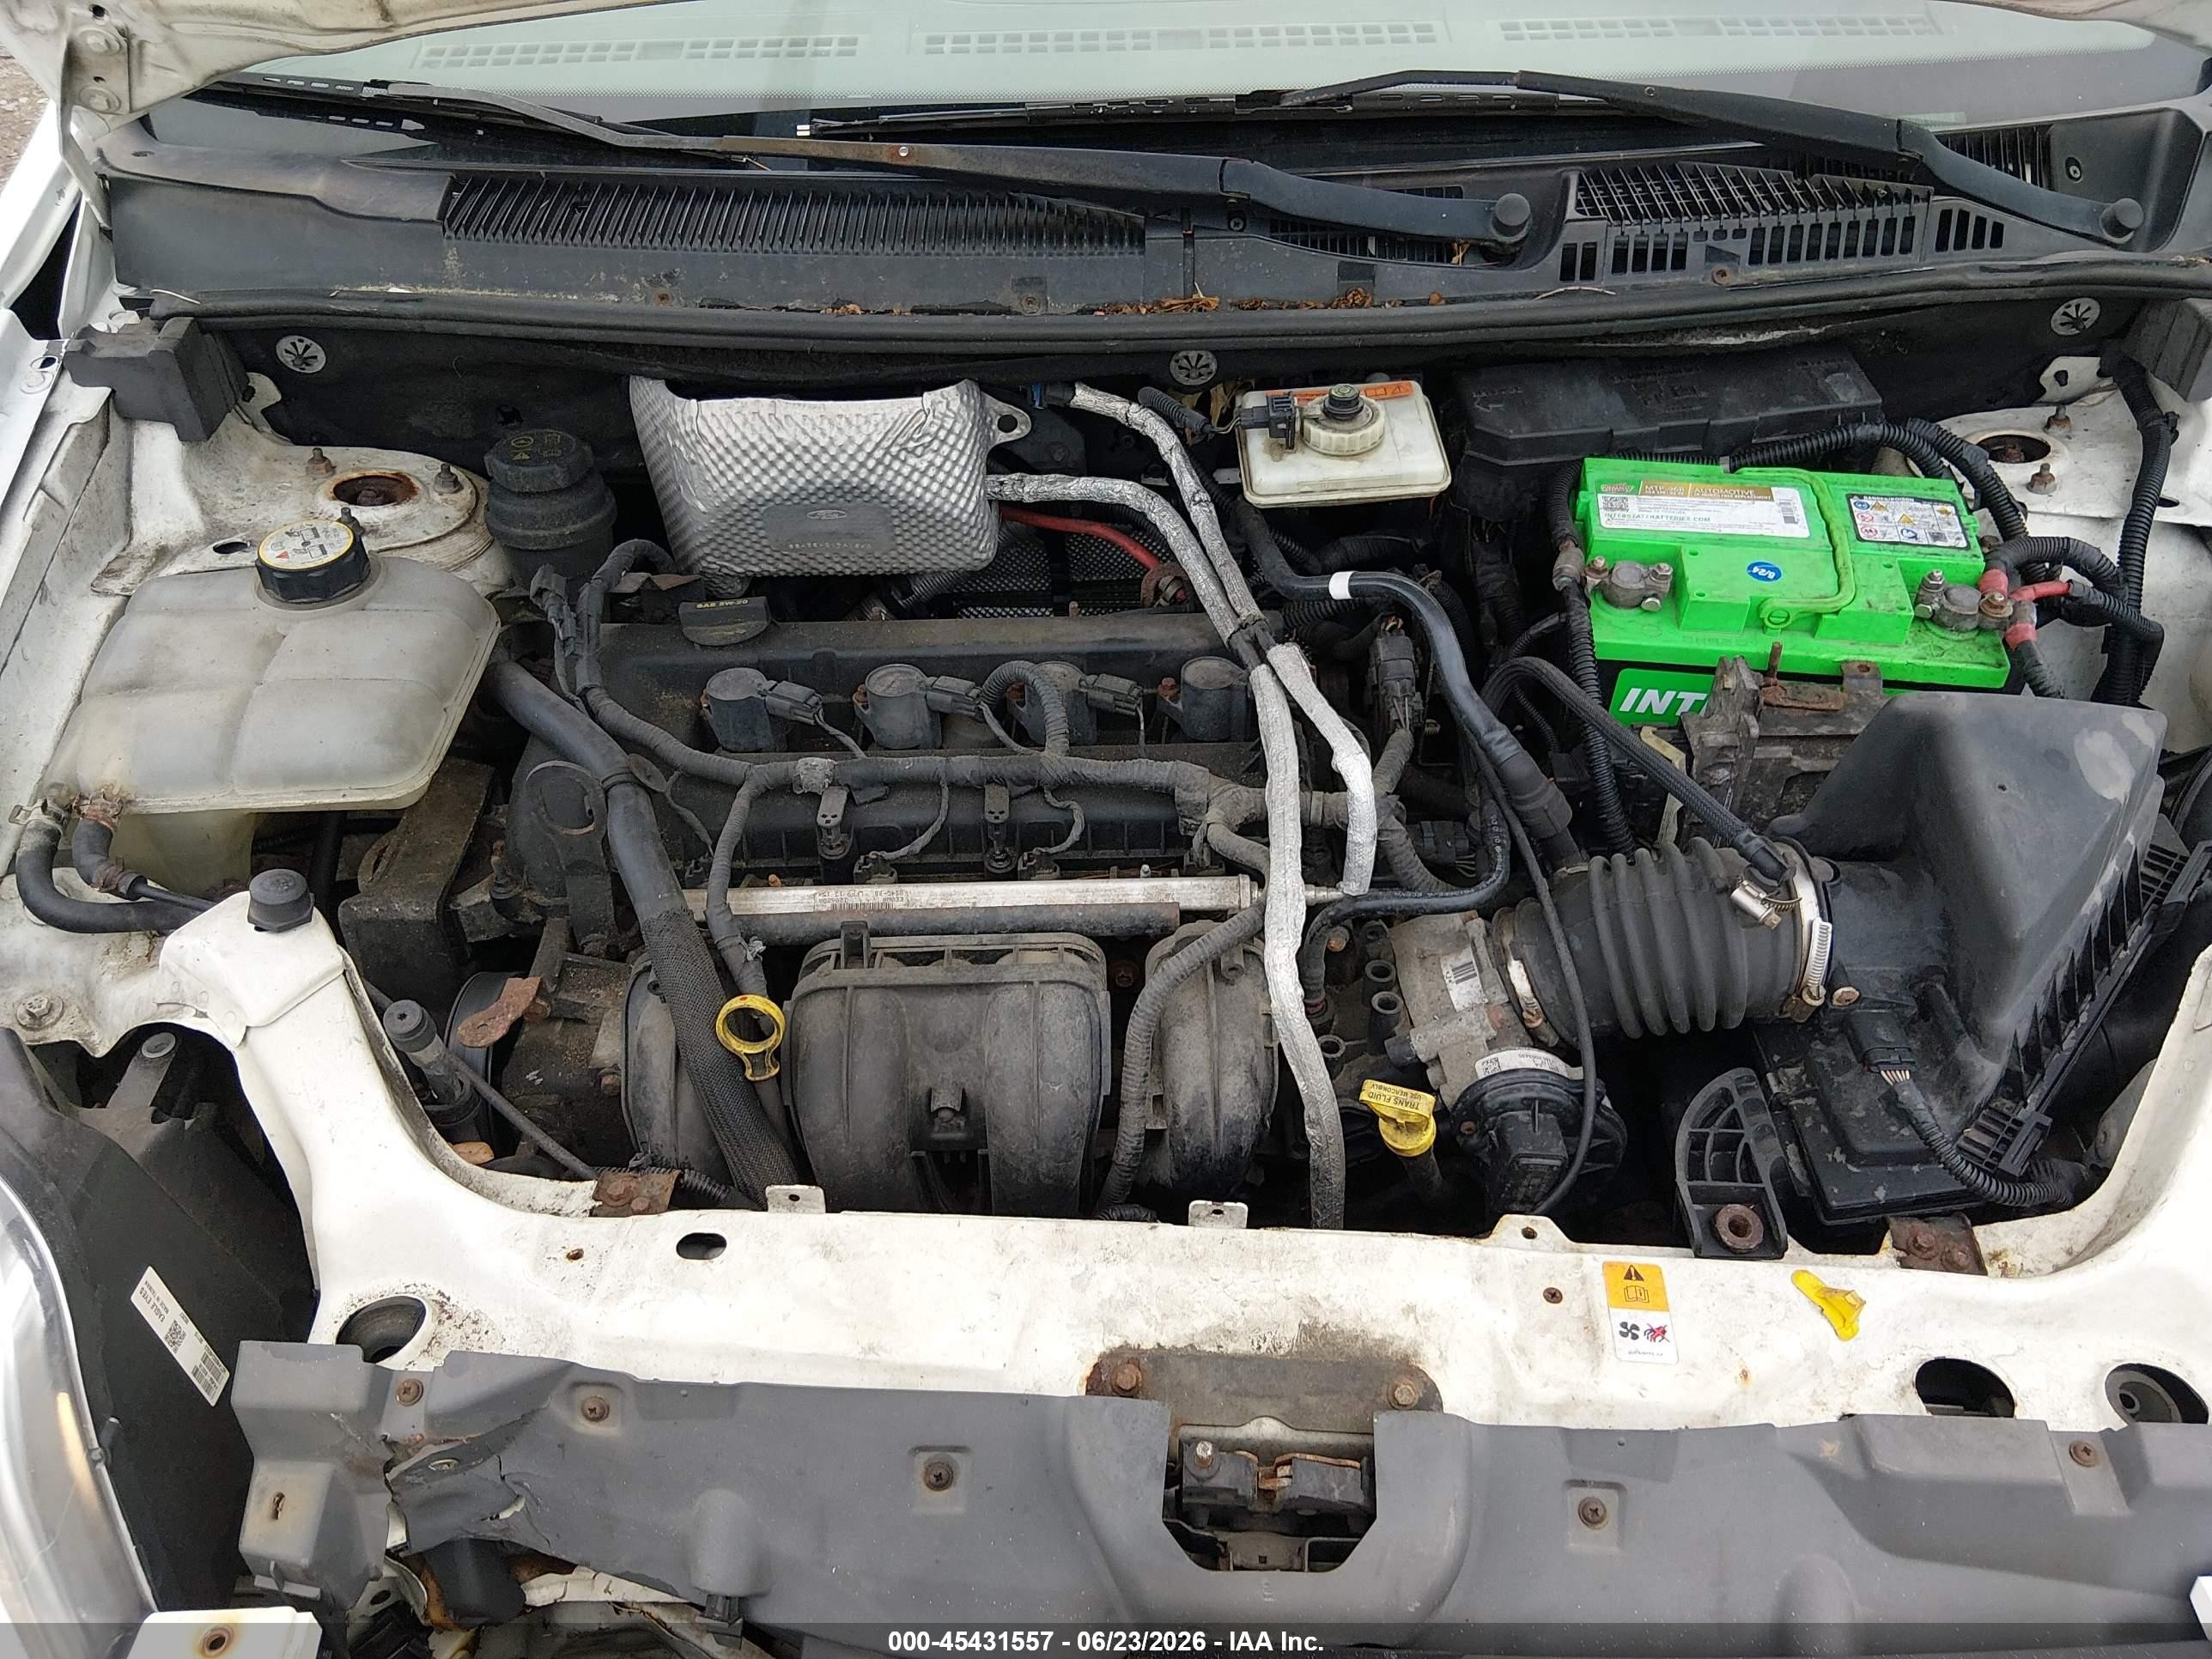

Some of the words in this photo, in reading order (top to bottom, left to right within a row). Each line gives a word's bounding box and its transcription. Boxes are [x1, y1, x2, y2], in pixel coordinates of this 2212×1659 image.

[1694, 487, 1754, 495] AUTOMOTIVE
[1619, 688, 1709, 716] INT
[1368, 1091, 1391, 1103] FLUID
[1409, 1092, 1422, 1101] USE
[1394, 1097, 1419, 1110] TRANS
[139, 1287, 152, 1304] EYES
[151, 1302, 165, 1322] EAGLE
